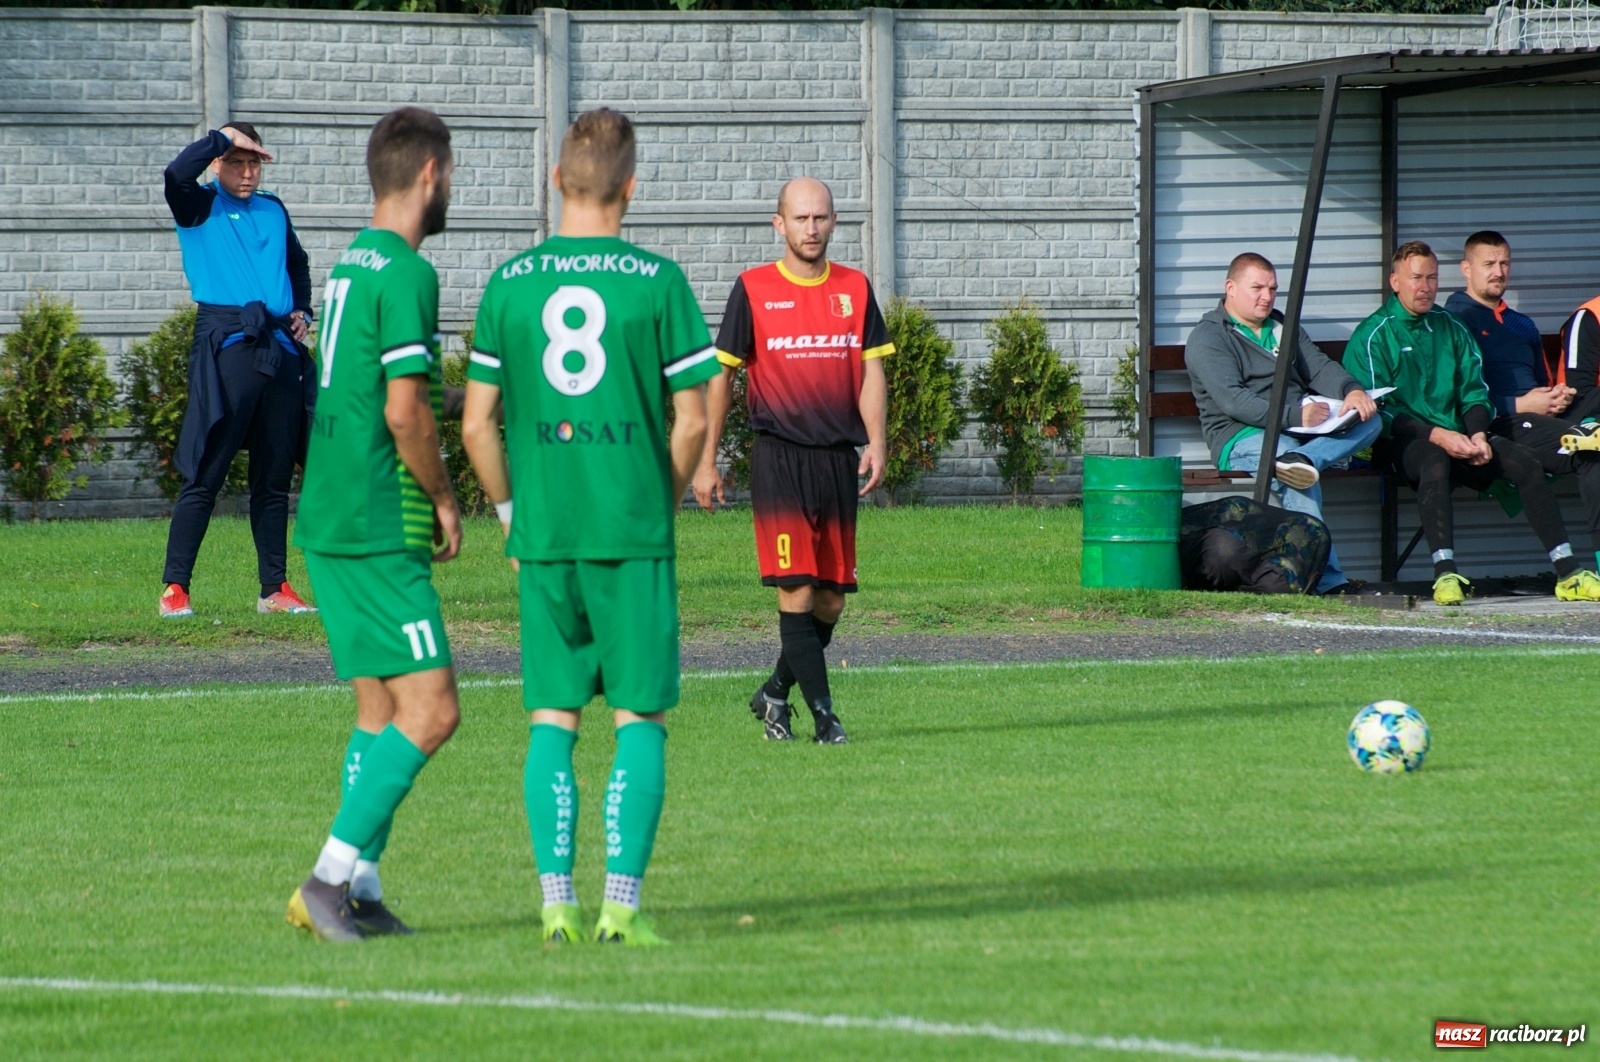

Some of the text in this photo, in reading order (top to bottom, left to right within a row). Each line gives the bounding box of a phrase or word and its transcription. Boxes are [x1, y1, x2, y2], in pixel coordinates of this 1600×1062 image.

[502, 254, 534, 279] LKS
[320, 277, 352, 388] 11
[541, 285, 607, 396] 8
[536, 419, 638, 444] ROSAT
[777, 533, 791, 570] 9
[402, 619, 437, 661] 11
